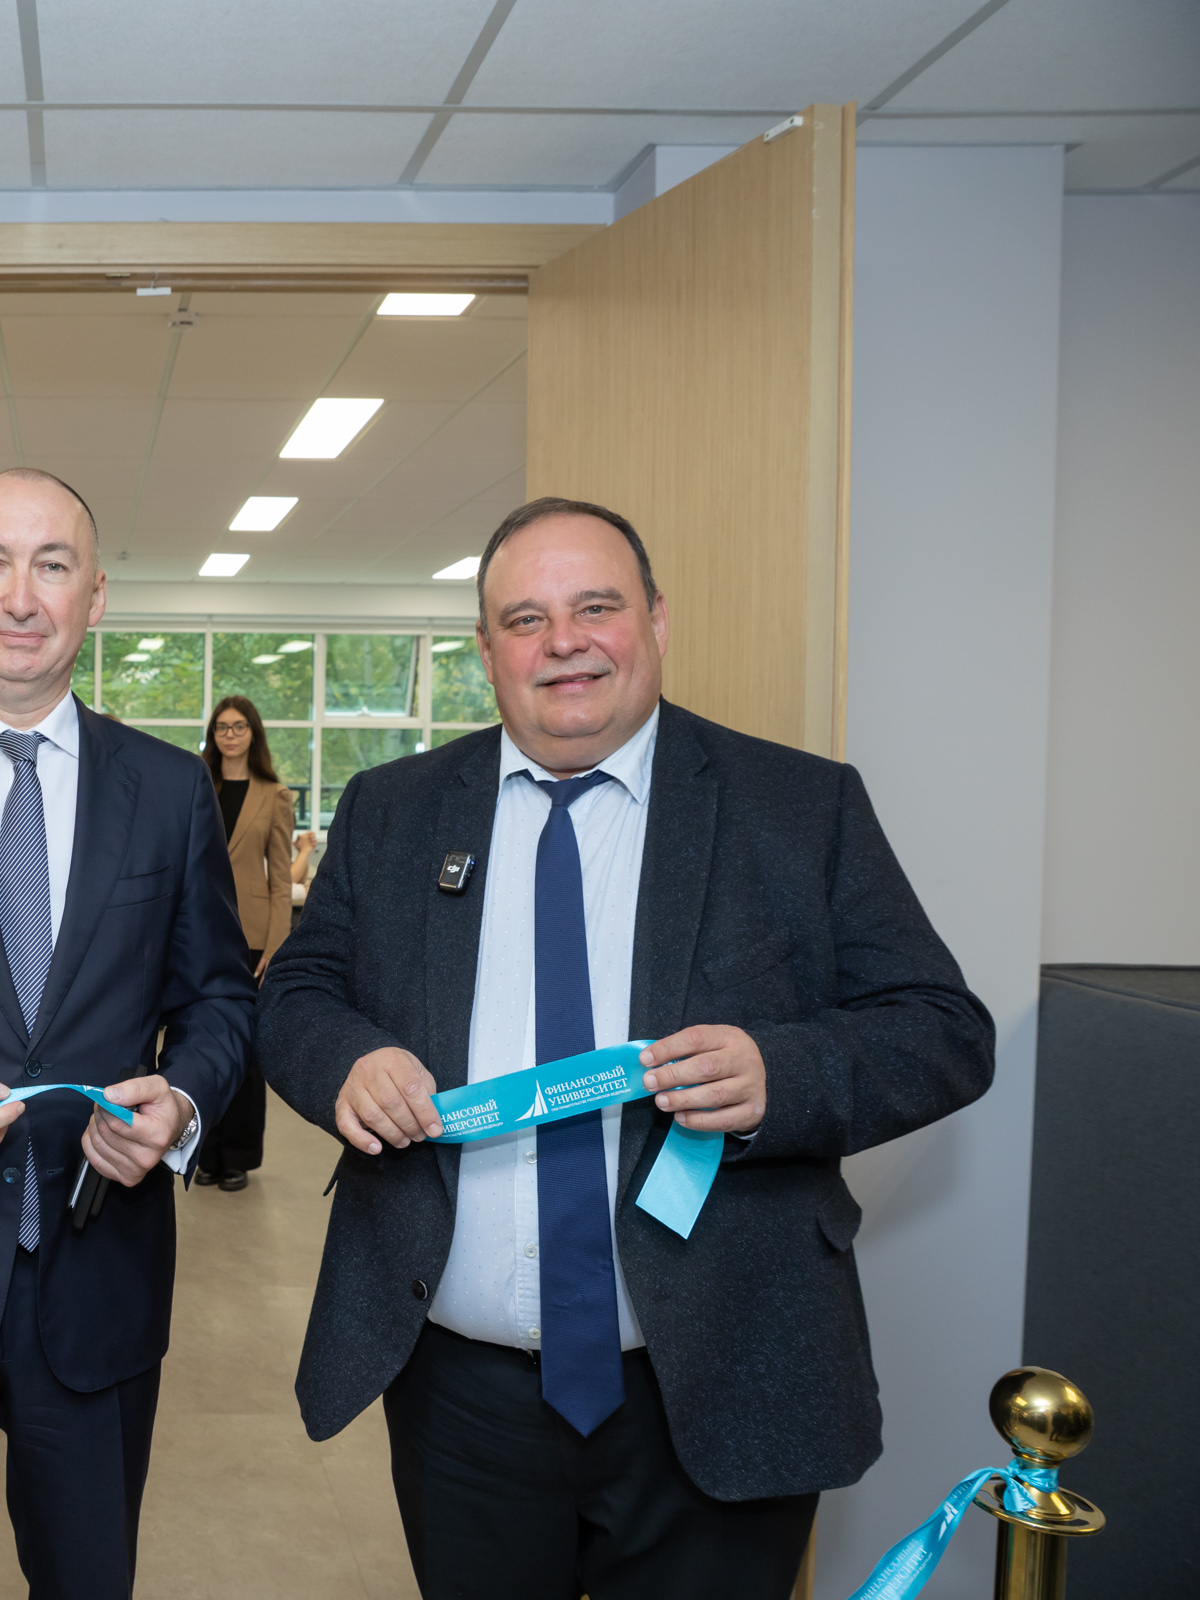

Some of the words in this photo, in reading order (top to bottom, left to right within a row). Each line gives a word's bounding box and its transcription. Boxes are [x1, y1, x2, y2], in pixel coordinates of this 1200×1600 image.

[544, 1065, 626, 1096] ФИНАНСОВЫЙ
[548, 1078, 628, 1107] УНИВЕРСИТЕТ
[440, 1099, 498, 1123] НАНСОВЫЙ
[442, 1112, 500, 1133] ИВЕРСИТЕТ
